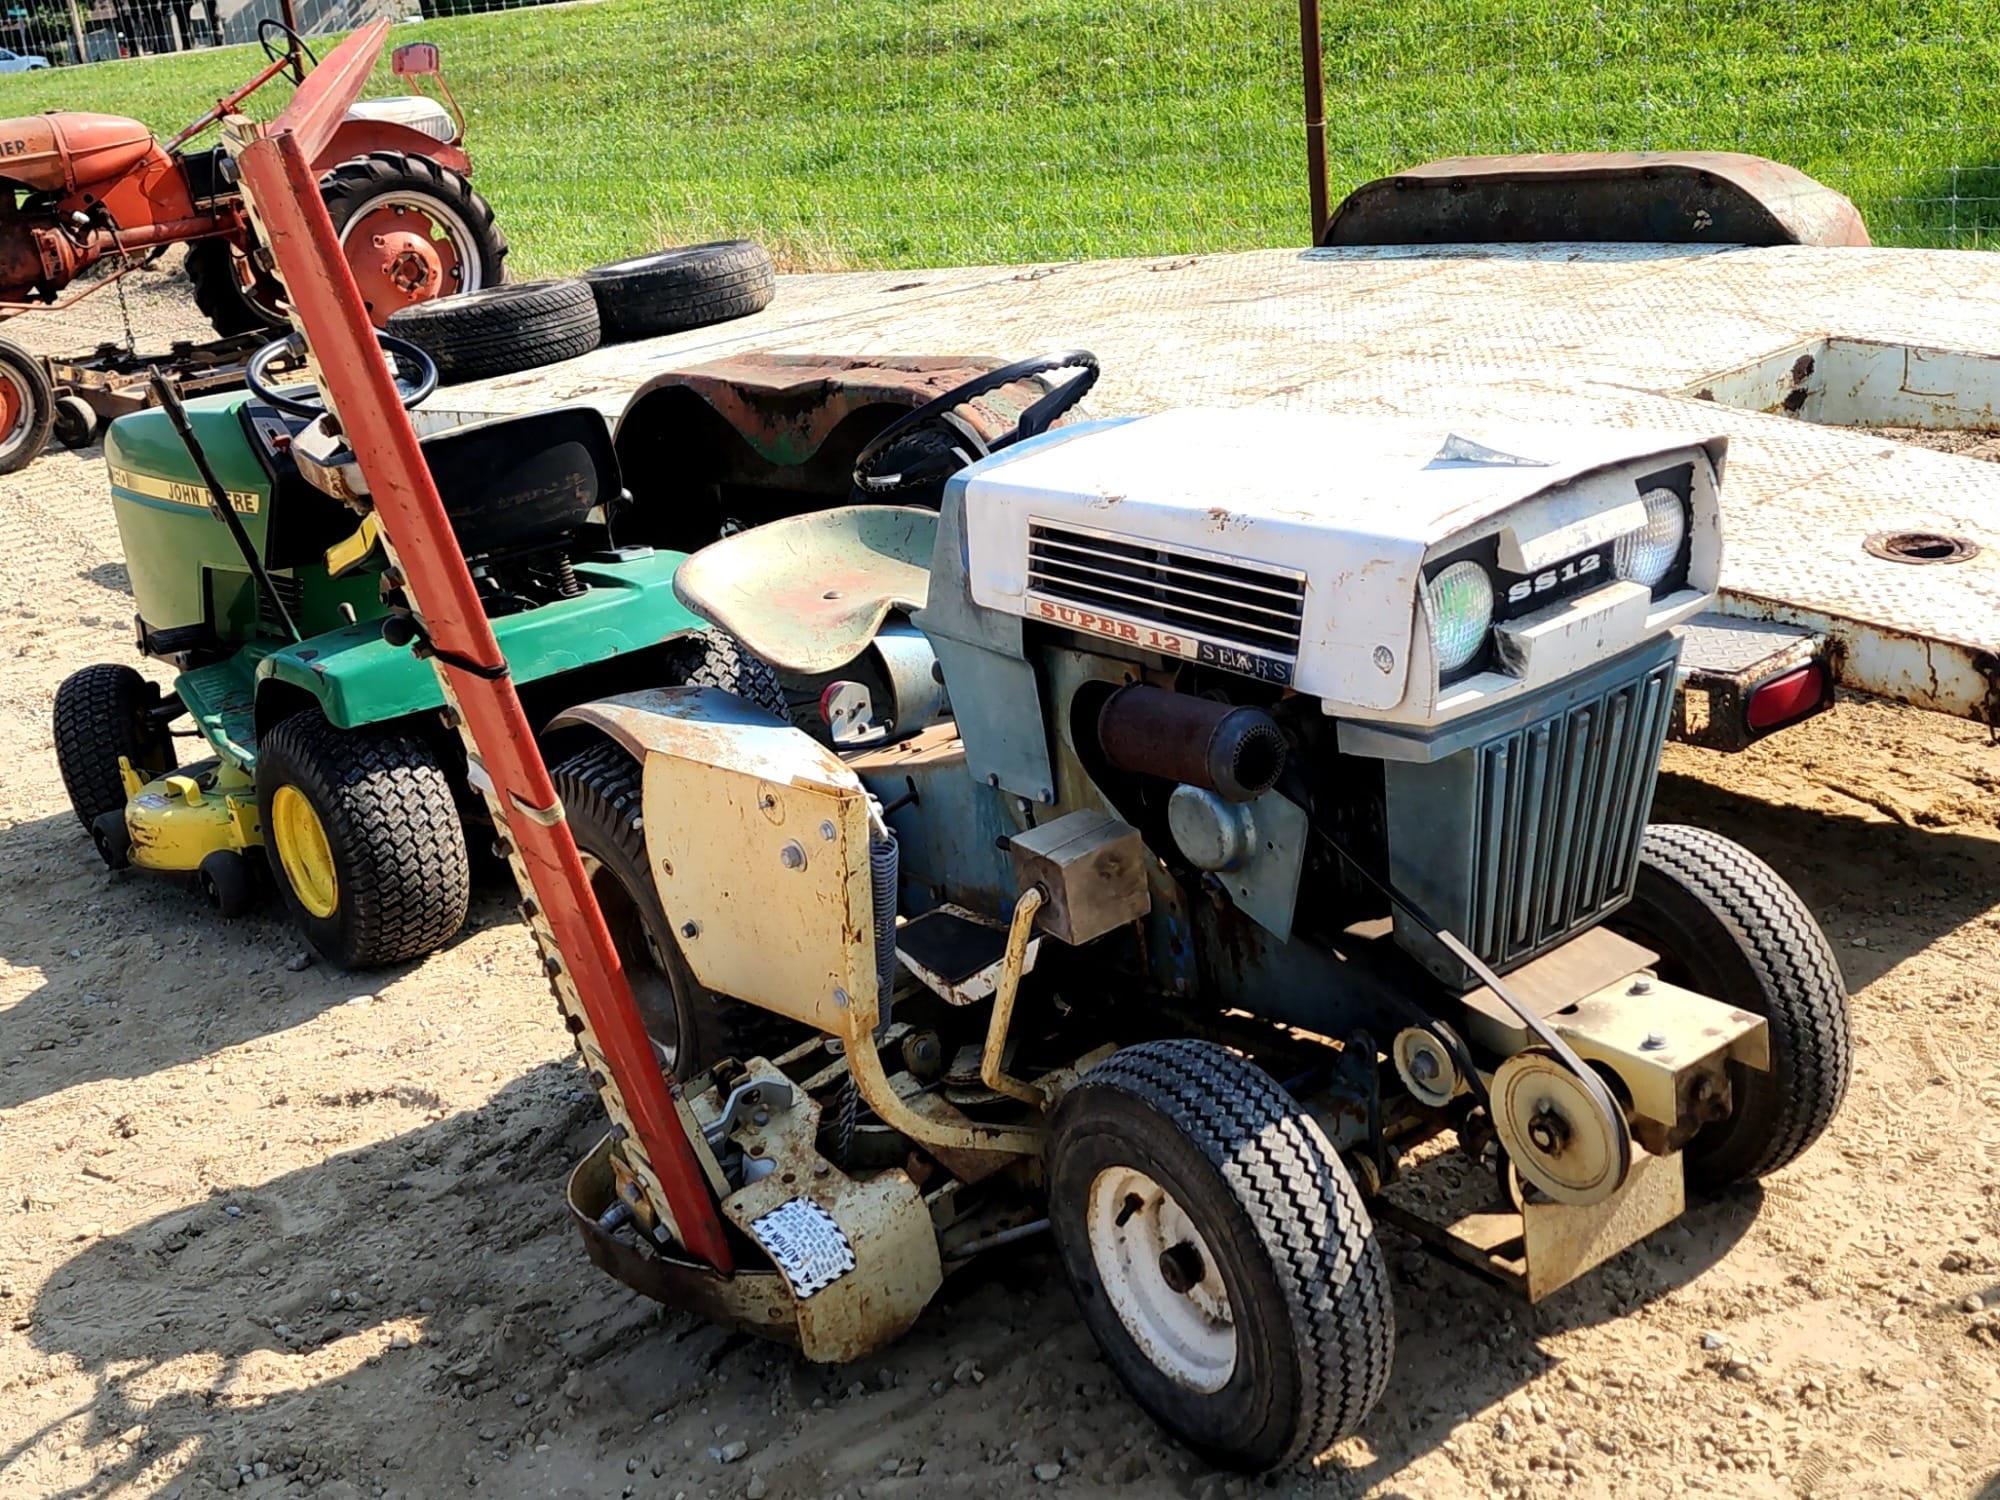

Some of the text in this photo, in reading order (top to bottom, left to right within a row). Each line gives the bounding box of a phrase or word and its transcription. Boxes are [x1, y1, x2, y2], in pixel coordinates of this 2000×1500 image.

[168, 483, 255, 512] JOHN DRE
[1508, 553, 1601, 604] SS12
[1039, 601, 1182, 654] SUPER 12
[1202, 644, 1287, 680] SEARS
[767, 1231, 804, 1271] CAUTION
